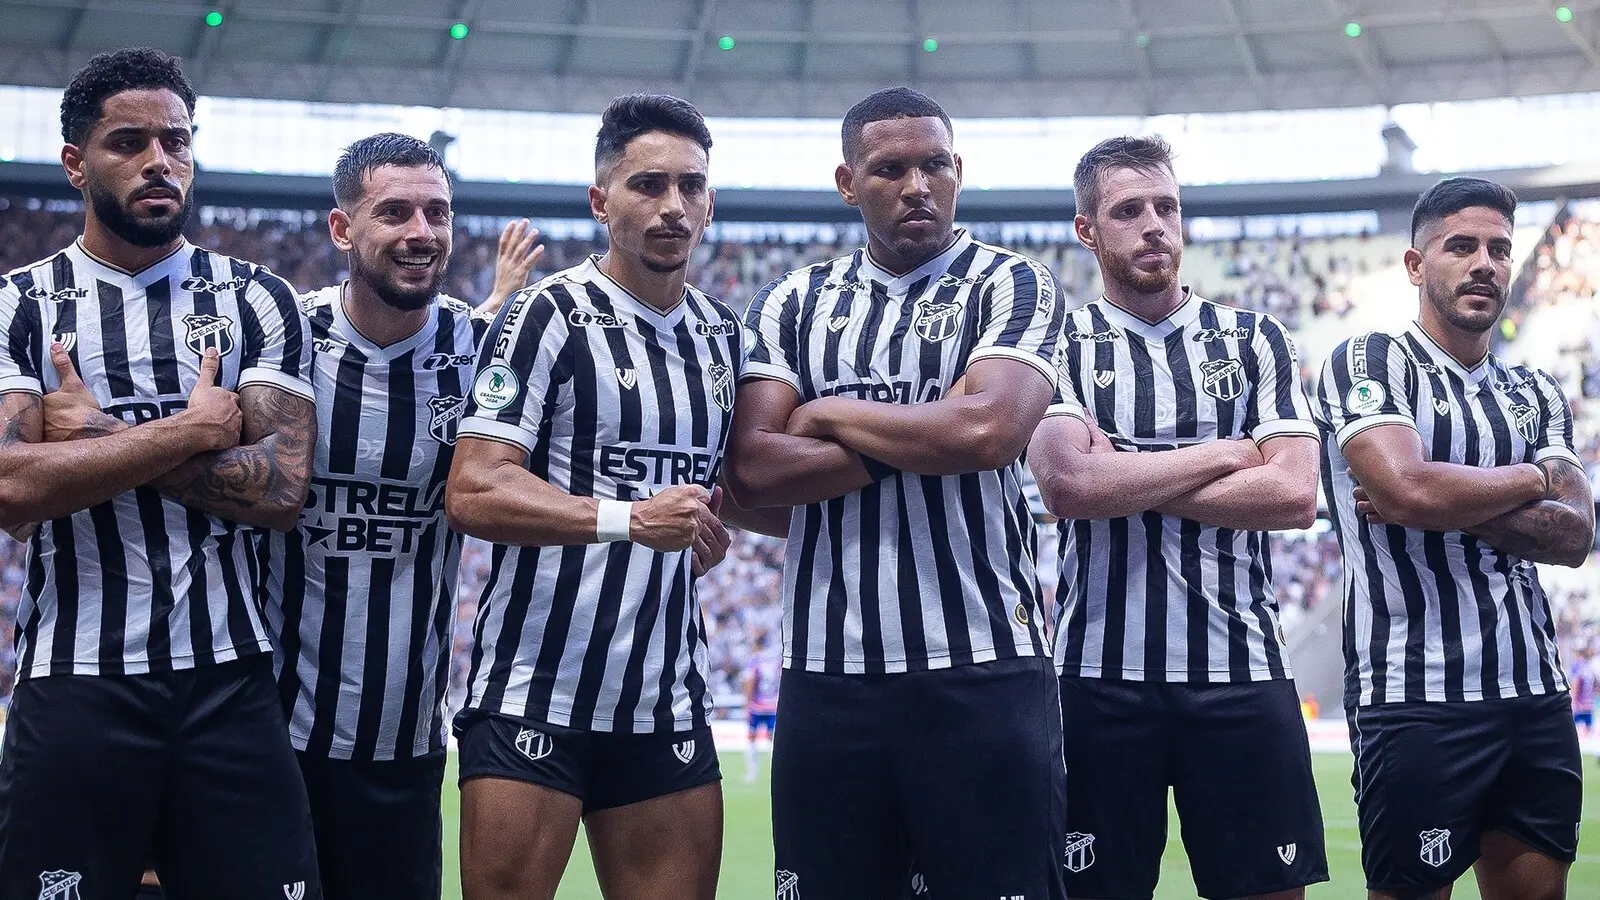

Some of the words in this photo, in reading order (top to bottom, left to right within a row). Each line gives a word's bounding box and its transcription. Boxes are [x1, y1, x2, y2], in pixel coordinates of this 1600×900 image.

[49, 287, 88, 302] zenir
[493, 288, 533, 360] ESTRELA
[312, 340, 335, 353] nir
[434, 406, 462, 426] CEAR
[600, 445, 722, 489] ESTREA
[303, 477, 445, 518] TRELA
[336, 517, 422, 554] BET
